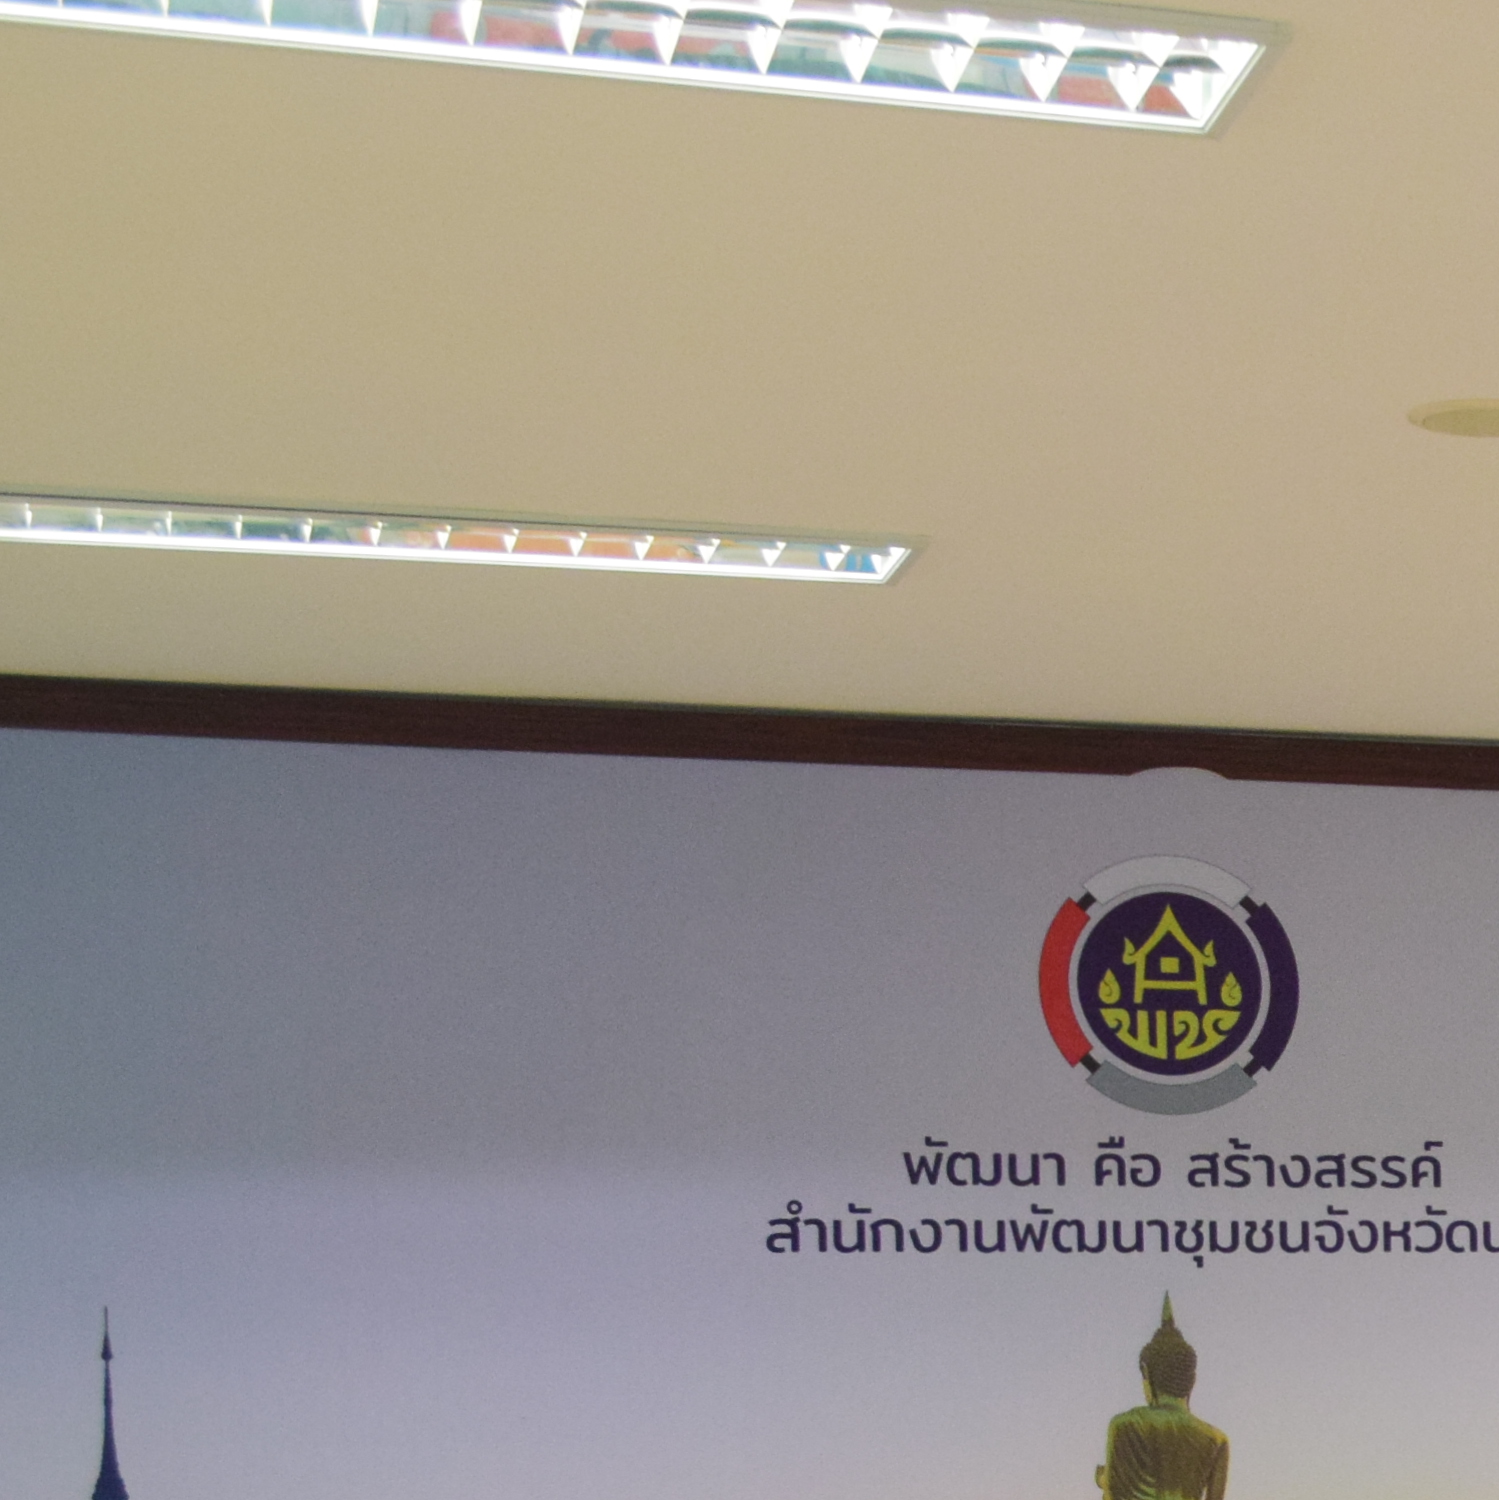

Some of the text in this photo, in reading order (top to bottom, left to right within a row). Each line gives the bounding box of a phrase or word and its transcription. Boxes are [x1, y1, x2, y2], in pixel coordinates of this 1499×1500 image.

[902, 1134, 1444, 1189] พัฒนา คือ สร้างสรรค์
